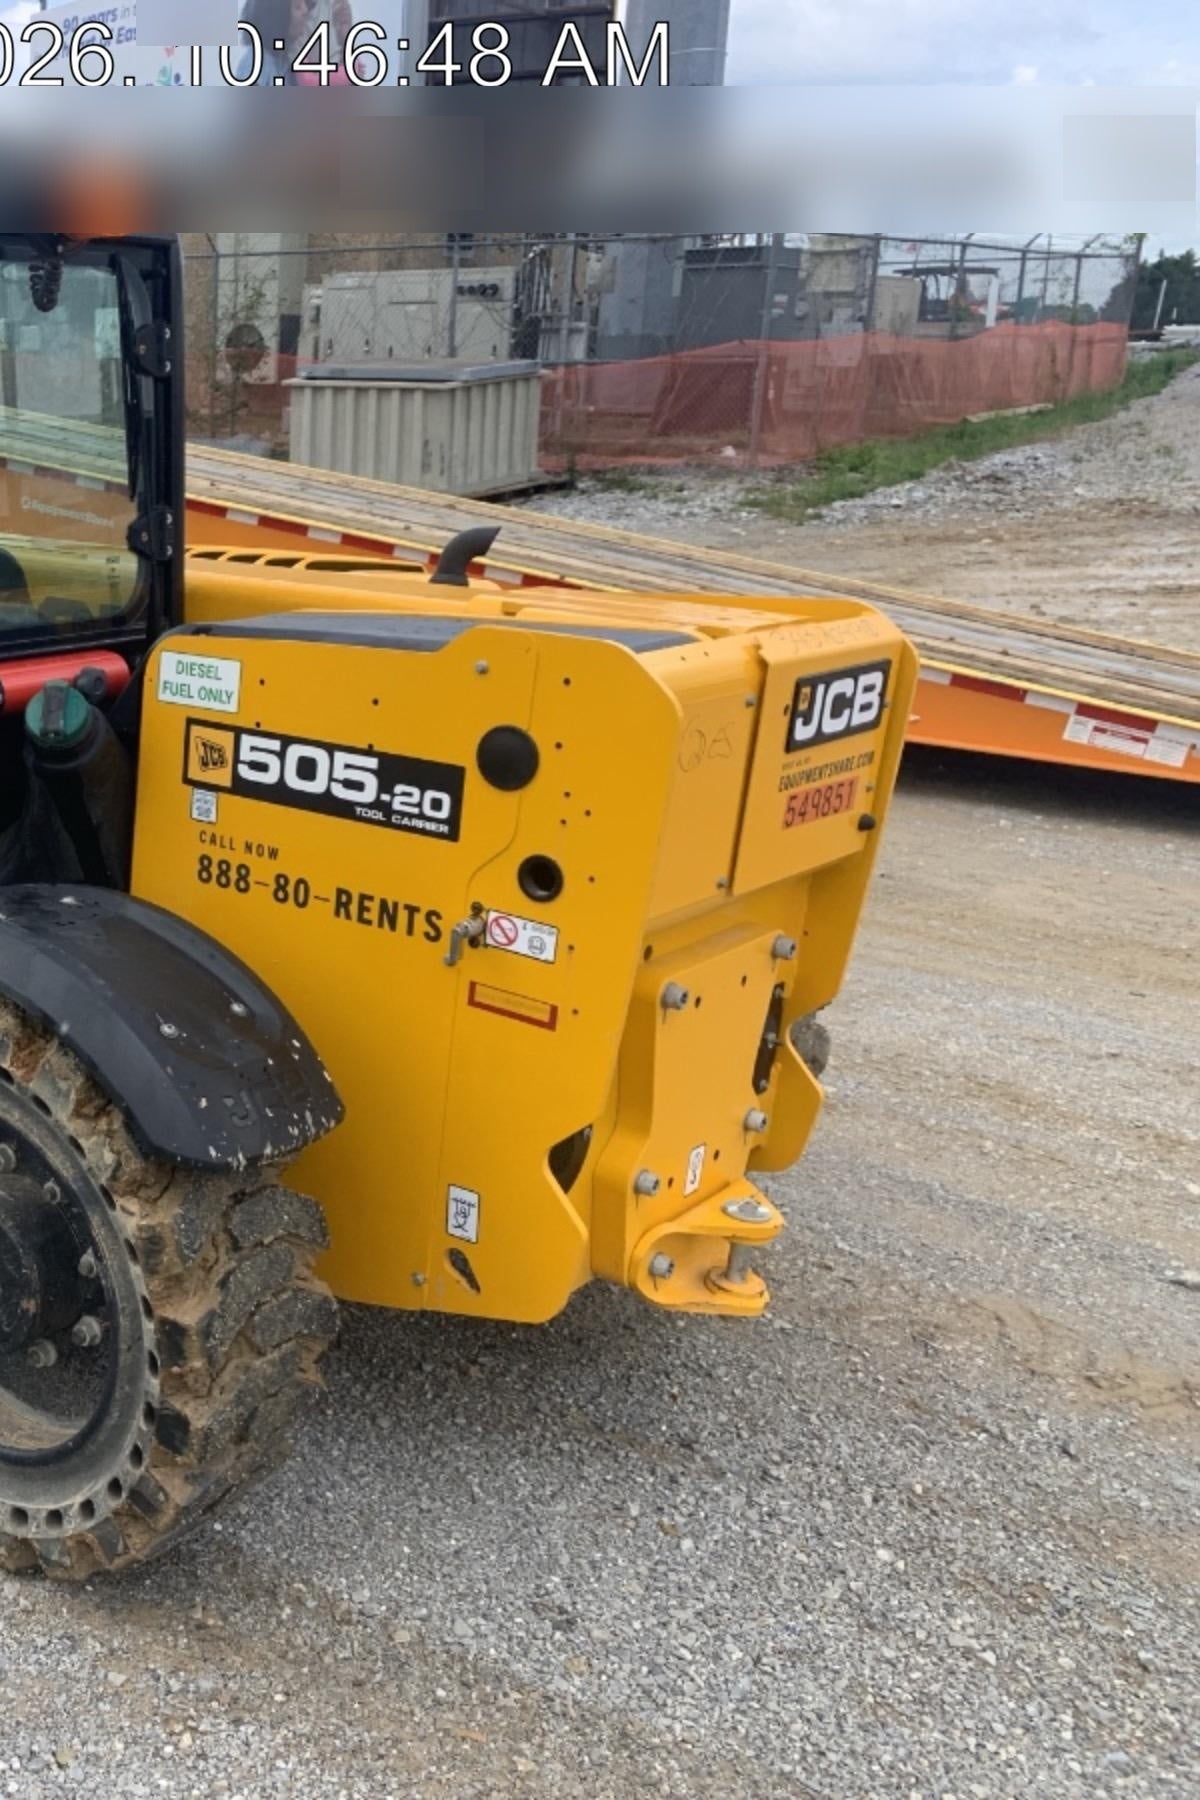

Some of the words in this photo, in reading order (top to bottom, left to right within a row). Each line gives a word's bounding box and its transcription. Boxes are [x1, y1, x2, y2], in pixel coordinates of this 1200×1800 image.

[175, 659, 223, 682] DIESEL
[161, 679, 195, 700] FUEL
[197, 684, 233, 706] ONLY
[794, 671, 883, 741] JCB
[200, 740, 227, 769] JCB
[778, 749, 875, 792] EQUIPMENTSHARE.COM
[237, 733, 451, 820] 505-20
[354, 805, 387, 822] TOOL
[391, 813, 449, 835] CARRIER
[785, 778, 855, 828] 549851
[199, 830, 237, 852] CALL
[243, 839, 280, 862] NOW
[197, 853, 444, 944] 888-80-RENTS
